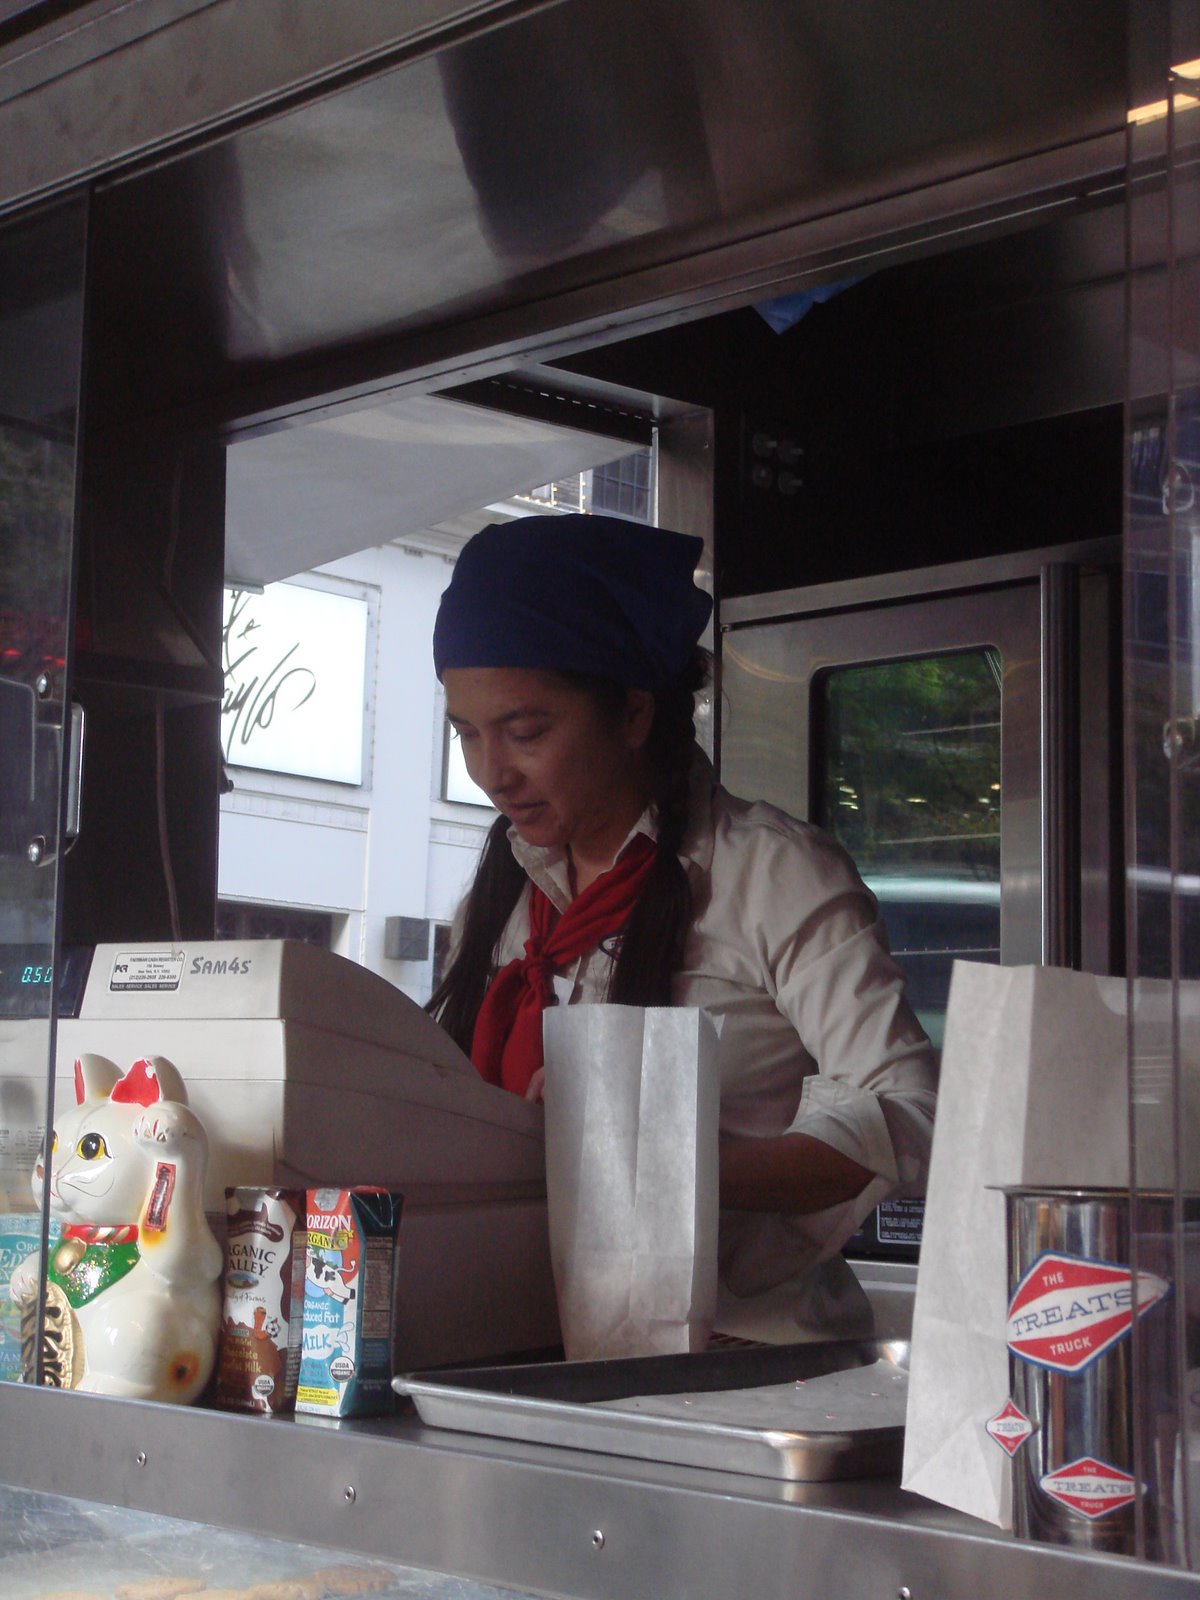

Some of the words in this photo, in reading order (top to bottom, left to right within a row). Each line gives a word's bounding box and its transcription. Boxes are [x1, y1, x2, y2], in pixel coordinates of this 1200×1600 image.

[306, 1214, 352, 1231] ORIZON
[307, 1232, 345, 1248] RGANIC
[229, 1243, 276, 1264] GANIC
[229, 1258, 268, 1276] ALLEY
[1042, 1271, 1064, 1288] THE
[324, 1312, 340, 1323] Fat
[1012, 1288, 1132, 1336] TREATS
[1050, 1336, 1092, 1356] TRUCK
[1053, 1481, 1132, 1494] TREATS
